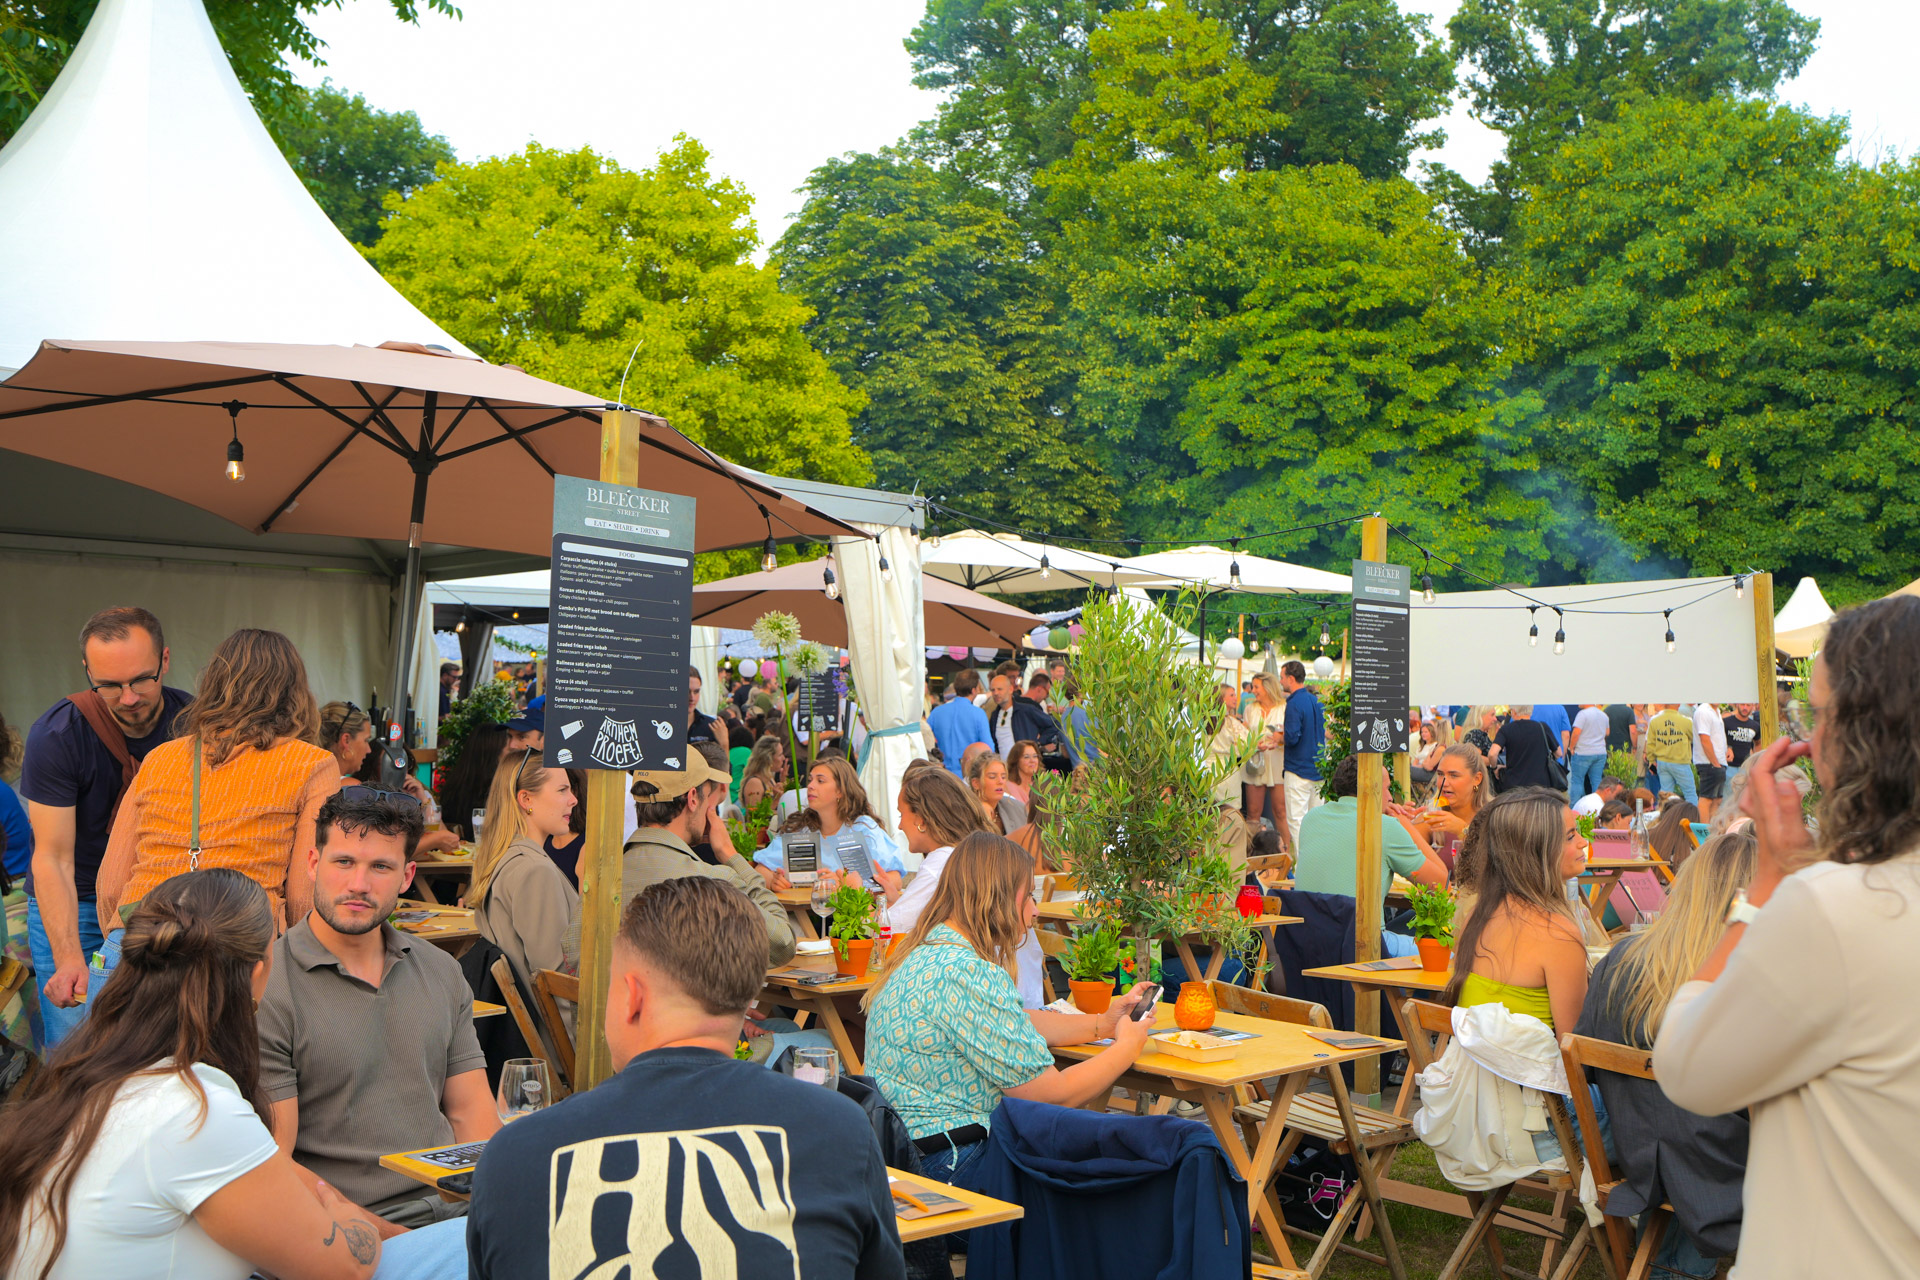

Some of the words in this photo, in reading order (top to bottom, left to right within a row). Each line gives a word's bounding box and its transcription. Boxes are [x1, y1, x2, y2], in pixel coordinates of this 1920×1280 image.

[587, 487, 670, 514] BLEECKER
[616, 509, 641, 518] STREET
[593, 520, 606, 528] EAT
[613, 524, 634, 532] SHARE
[640, 527, 660, 536] DRINK
[1365, 565, 1400, 580] BLEECKER
[576, 588, 588, 596] sticky
[600, 608, 613, 616] brood
[626, 611, 640, 619] dippen
